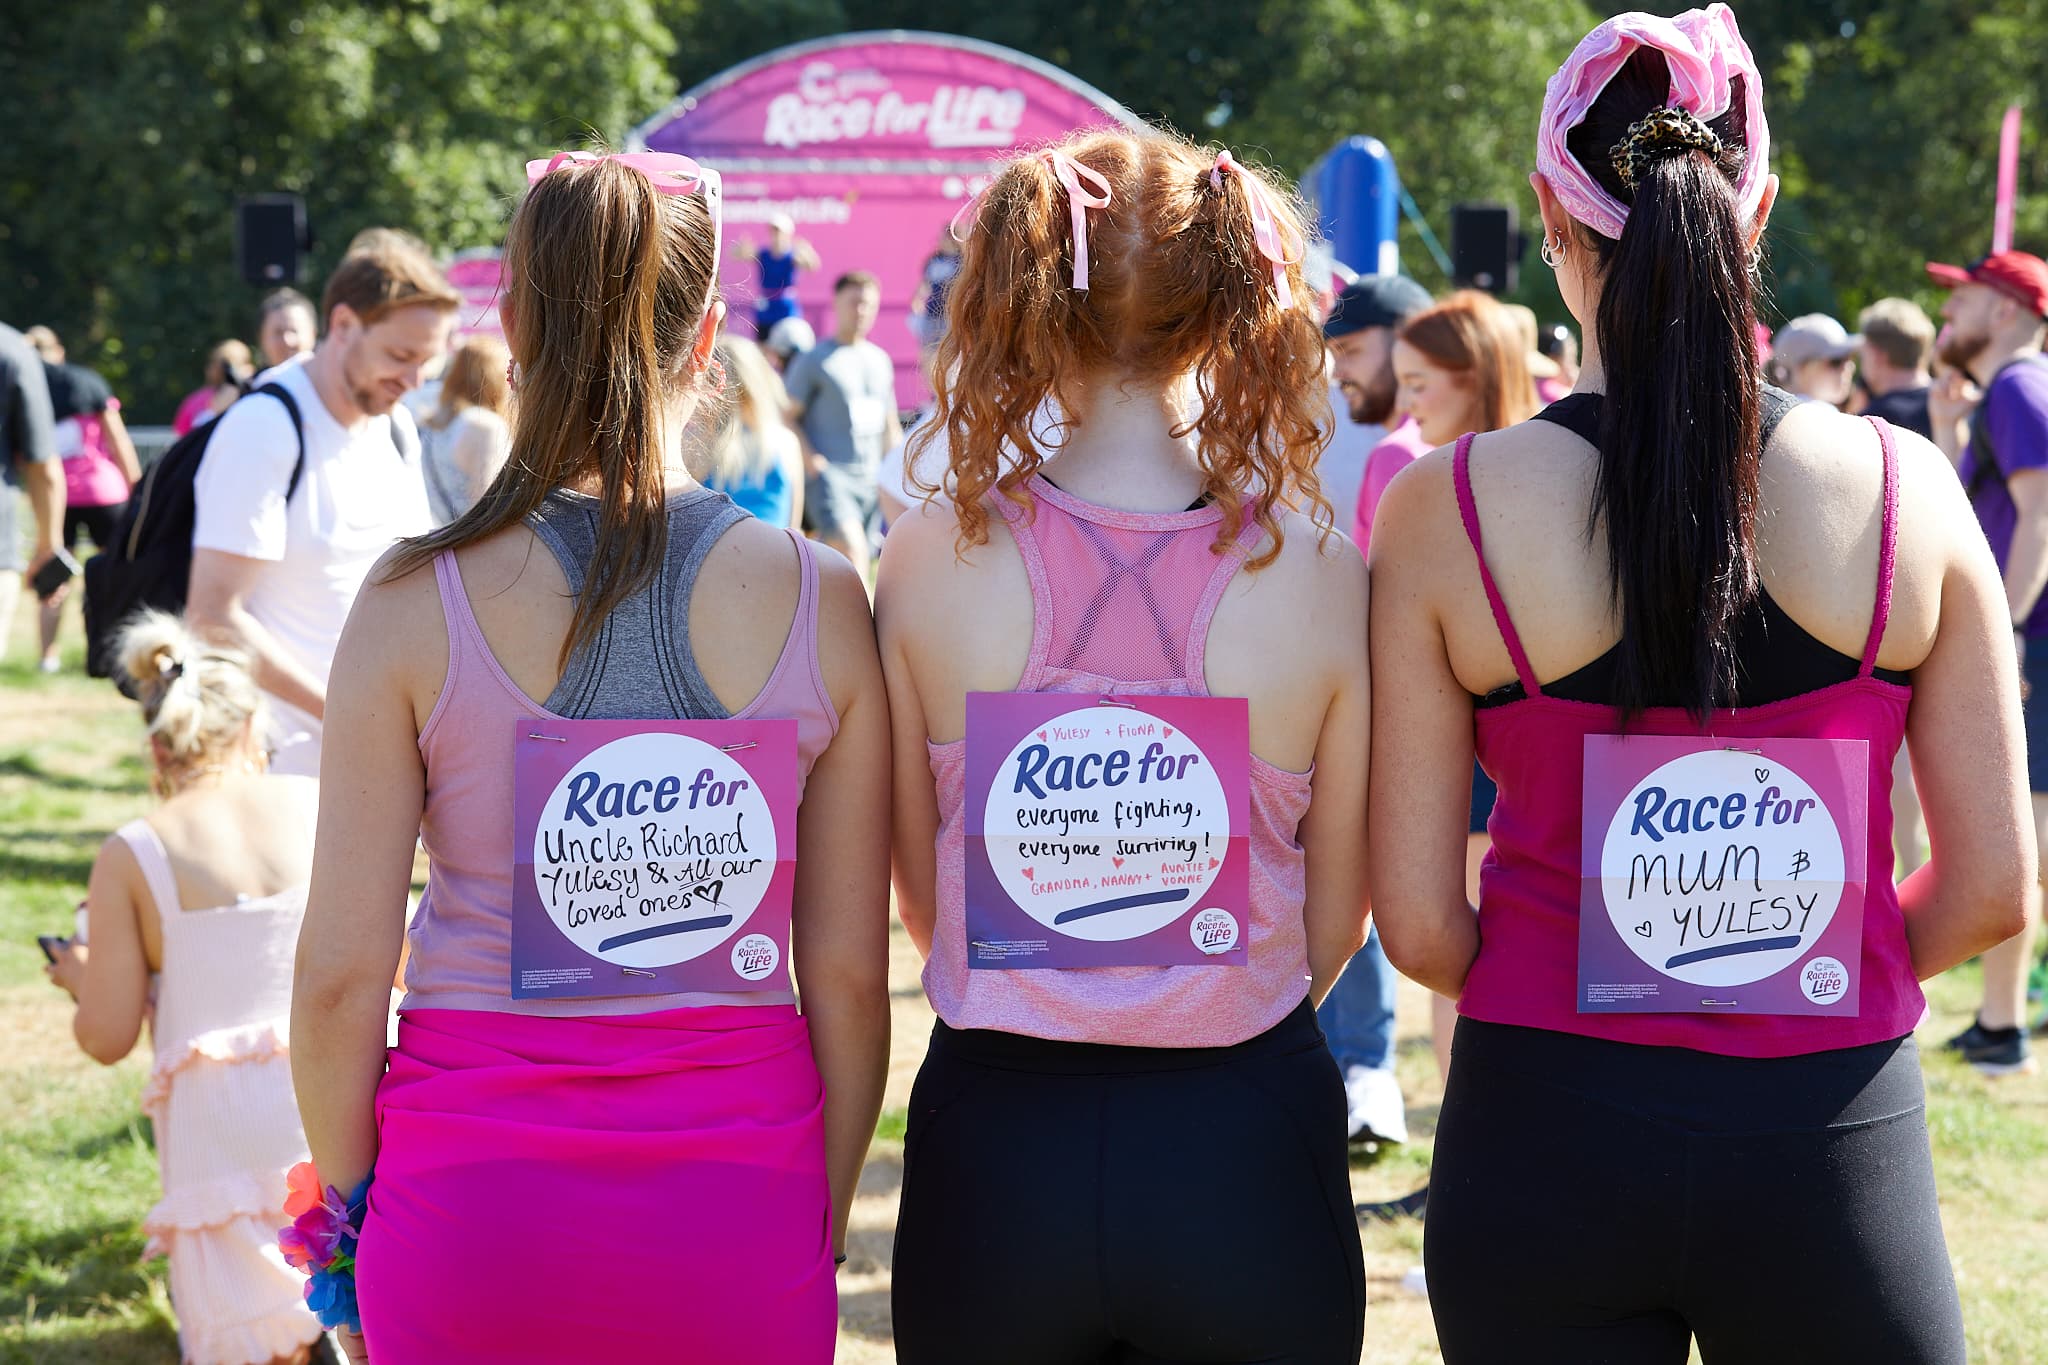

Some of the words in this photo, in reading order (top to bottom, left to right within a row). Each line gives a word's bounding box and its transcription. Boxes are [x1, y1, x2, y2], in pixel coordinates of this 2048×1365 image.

[763, 93, 872, 147] Race
[872, 92, 928, 136] for
[926, 86, 1026, 138] Life
[1053, 727, 1090, 741] YULESY
[1118, 723, 1155, 738] FIONA
[1013, 744, 1130, 800] Race
[1138, 742, 1199, 784] for
[564, 771, 681, 827] Race
[688, 768, 748, 810] for
[1016, 807, 1100, 836] everyone
[1630, 786, 1747, 842] Race
[1754, 786, 1816, 827] for
[544, 828, 633, 863] Uncle
[640, 812, 748, 859] Richard
[1018, 841, 1101, 865] everyone
[1161, 862, 1205, 875] AUNTIE
[1162, 874, 1204, 886] VONNE
[1628, 844, 1763, 900] MUM
[541, 864, 639, 906] Yulesy
[646, 862, 669, 884] &
[721, 858, 762, 878] our
[567, 895, 627, 928] loved
[639, 891, 692, 916] ones
[1673, 892, 1818, 947] YULESY
[1196, 921, 1218, 932] Race
[1218, 921, 1230, 929] for
[1202, 929, 1231, 944] Life
[737, 947, 759, 958] Race
[760, 947, 771, 955] for
[743, 955, 772, 970] Life
[1806, 970, 1828, 981] Race
[1828, 970, 1840, 978] for
[1811, 979, 1841, 994] Life
